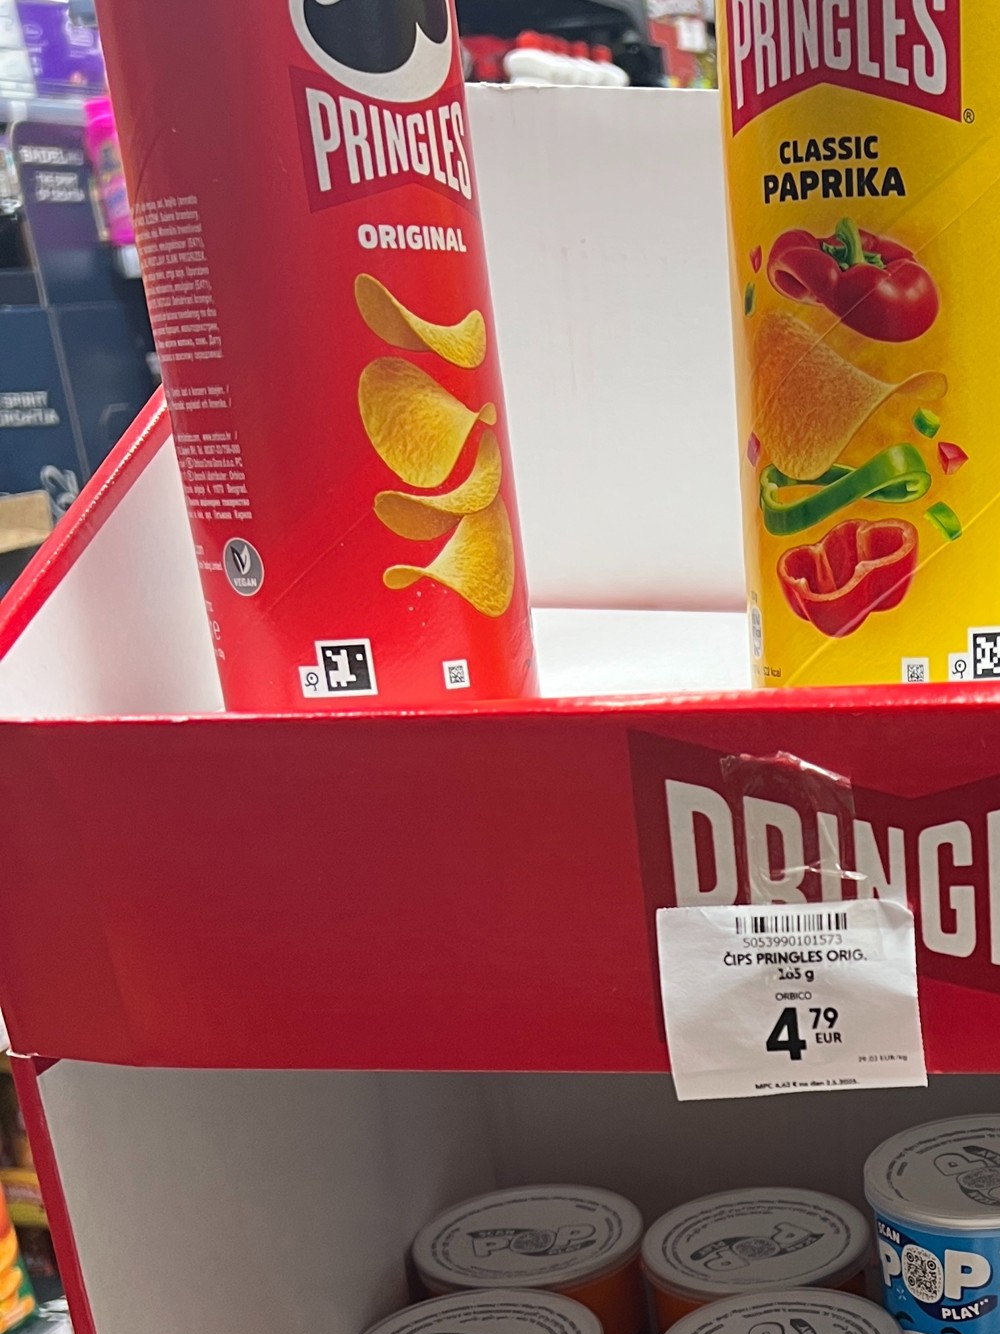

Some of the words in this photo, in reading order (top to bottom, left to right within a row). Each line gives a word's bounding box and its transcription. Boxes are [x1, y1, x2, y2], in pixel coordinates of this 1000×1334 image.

[732, 0, 947, 110] PRINGLES
[305, 87, 472, 200] PRINGLES
[779, 135, 879, 165] CLASSIC
[763, 167, 906, 204] PAPRIKA
[357, 223, 467, 252] ORIGINAL
[233, 578, 257, 587] VEGAN
[743, 934, 843, 948] 5053990101573
[723, 951, 753, 966] ČIPS
[757, 950, 823, 964] PRINGLES
[826, 949, 868, 962] ORIG.
[805, 970, 815, 982] g
[775, 991, 812, 1001] ORBICO
[766, 1007, 807, 1061] 4
[809, 1007, 839, 1030] 79
[816, 1032, 842, 1044] EUR
[877, 1221, 901, 1244] SCAN
